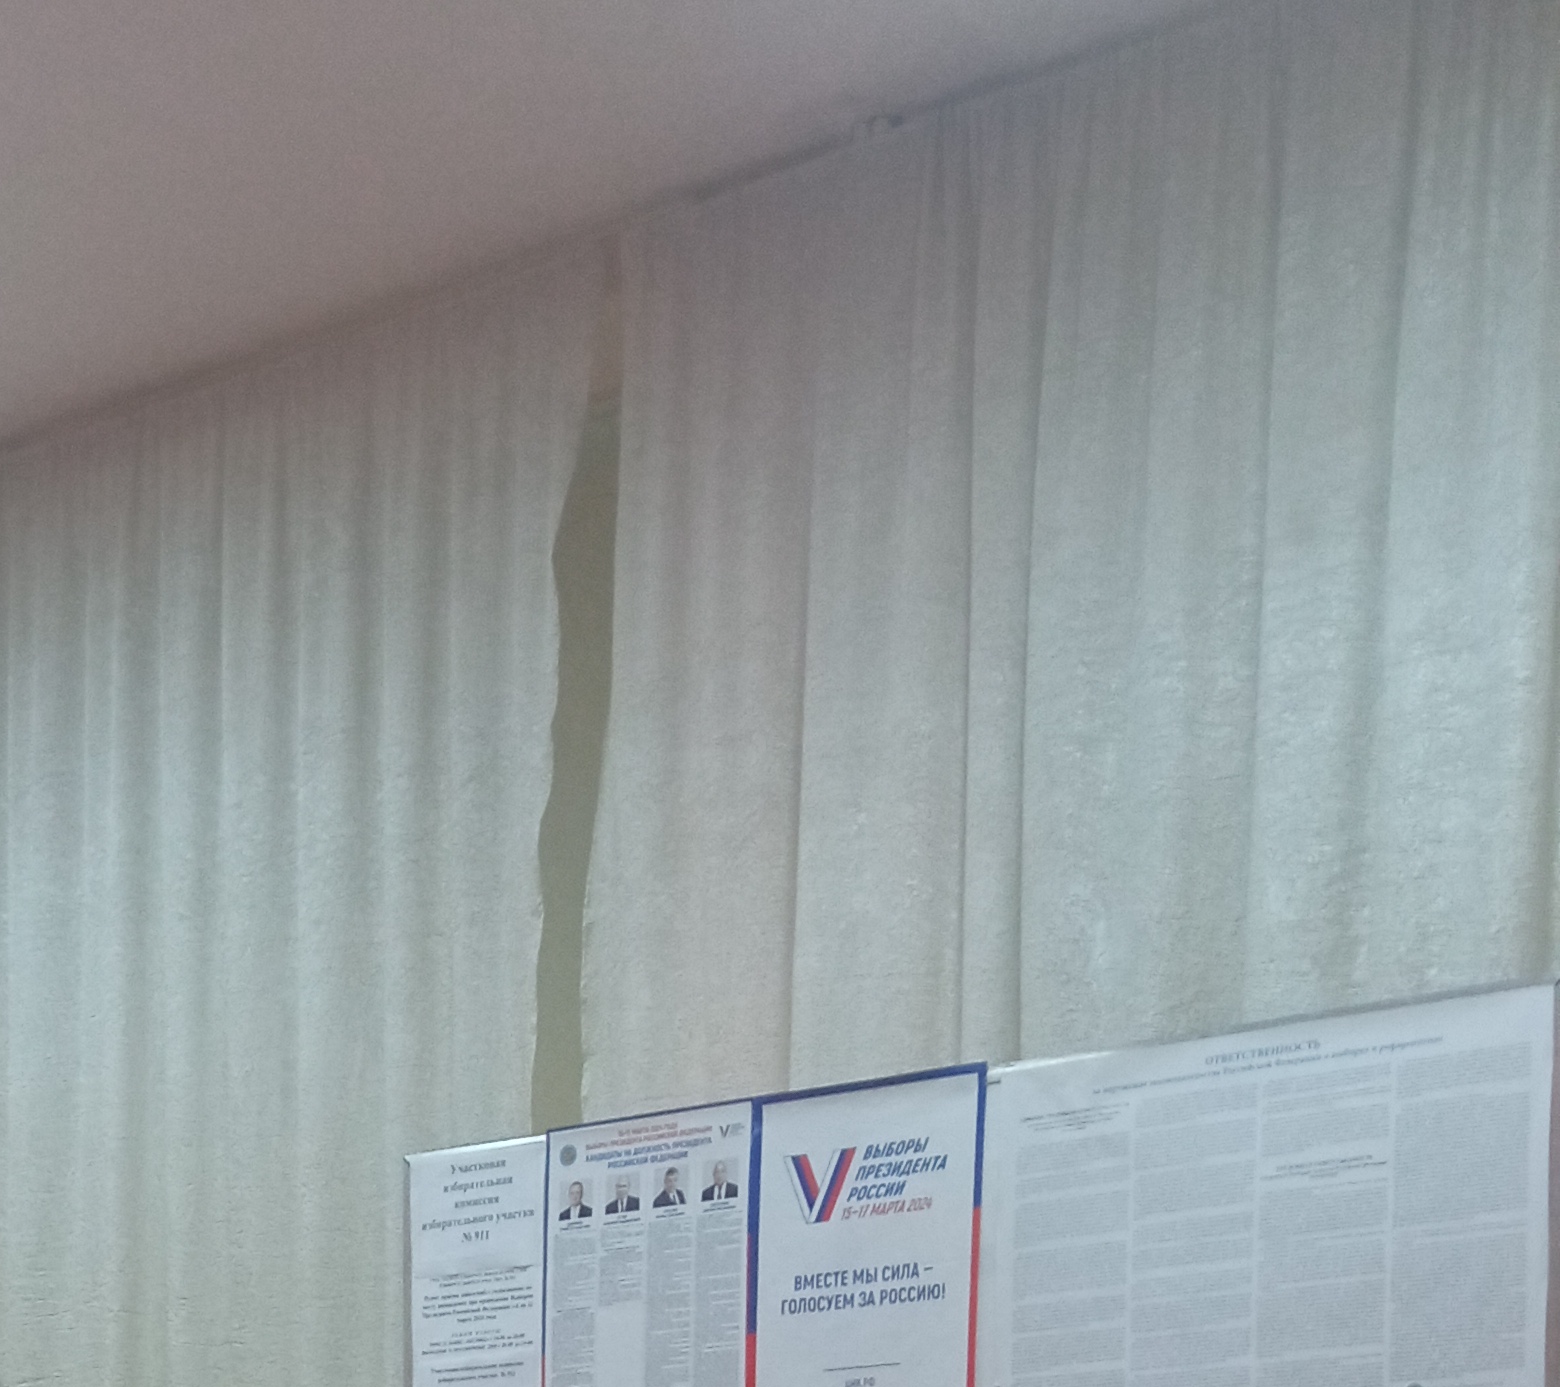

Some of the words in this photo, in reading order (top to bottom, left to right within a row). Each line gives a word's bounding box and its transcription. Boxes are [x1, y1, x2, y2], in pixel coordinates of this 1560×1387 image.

[863, 1136, 930, 1161] ВЫБОРЫ
[855, 1154, 949, 1182] ПРЕЗИДЕНТА
[847, 1180, 907, 1202] РОССИИ
[870, 1200, 905, 1216] МАРТА
[907, 1197, 933, 1212] 2024
[794, 1270, 849, 1292] ВМЕСТЕ
[852, 1267, 878, 1285] МЫ
[882, 1262, 920, 1282] СИЛА
[781, 1293, 855, 1315] ГОЛОСУЕМ
[858, 1290, 876, 1308] ЗА
[879, 1282, 946, 1306] РОССИЮ!
